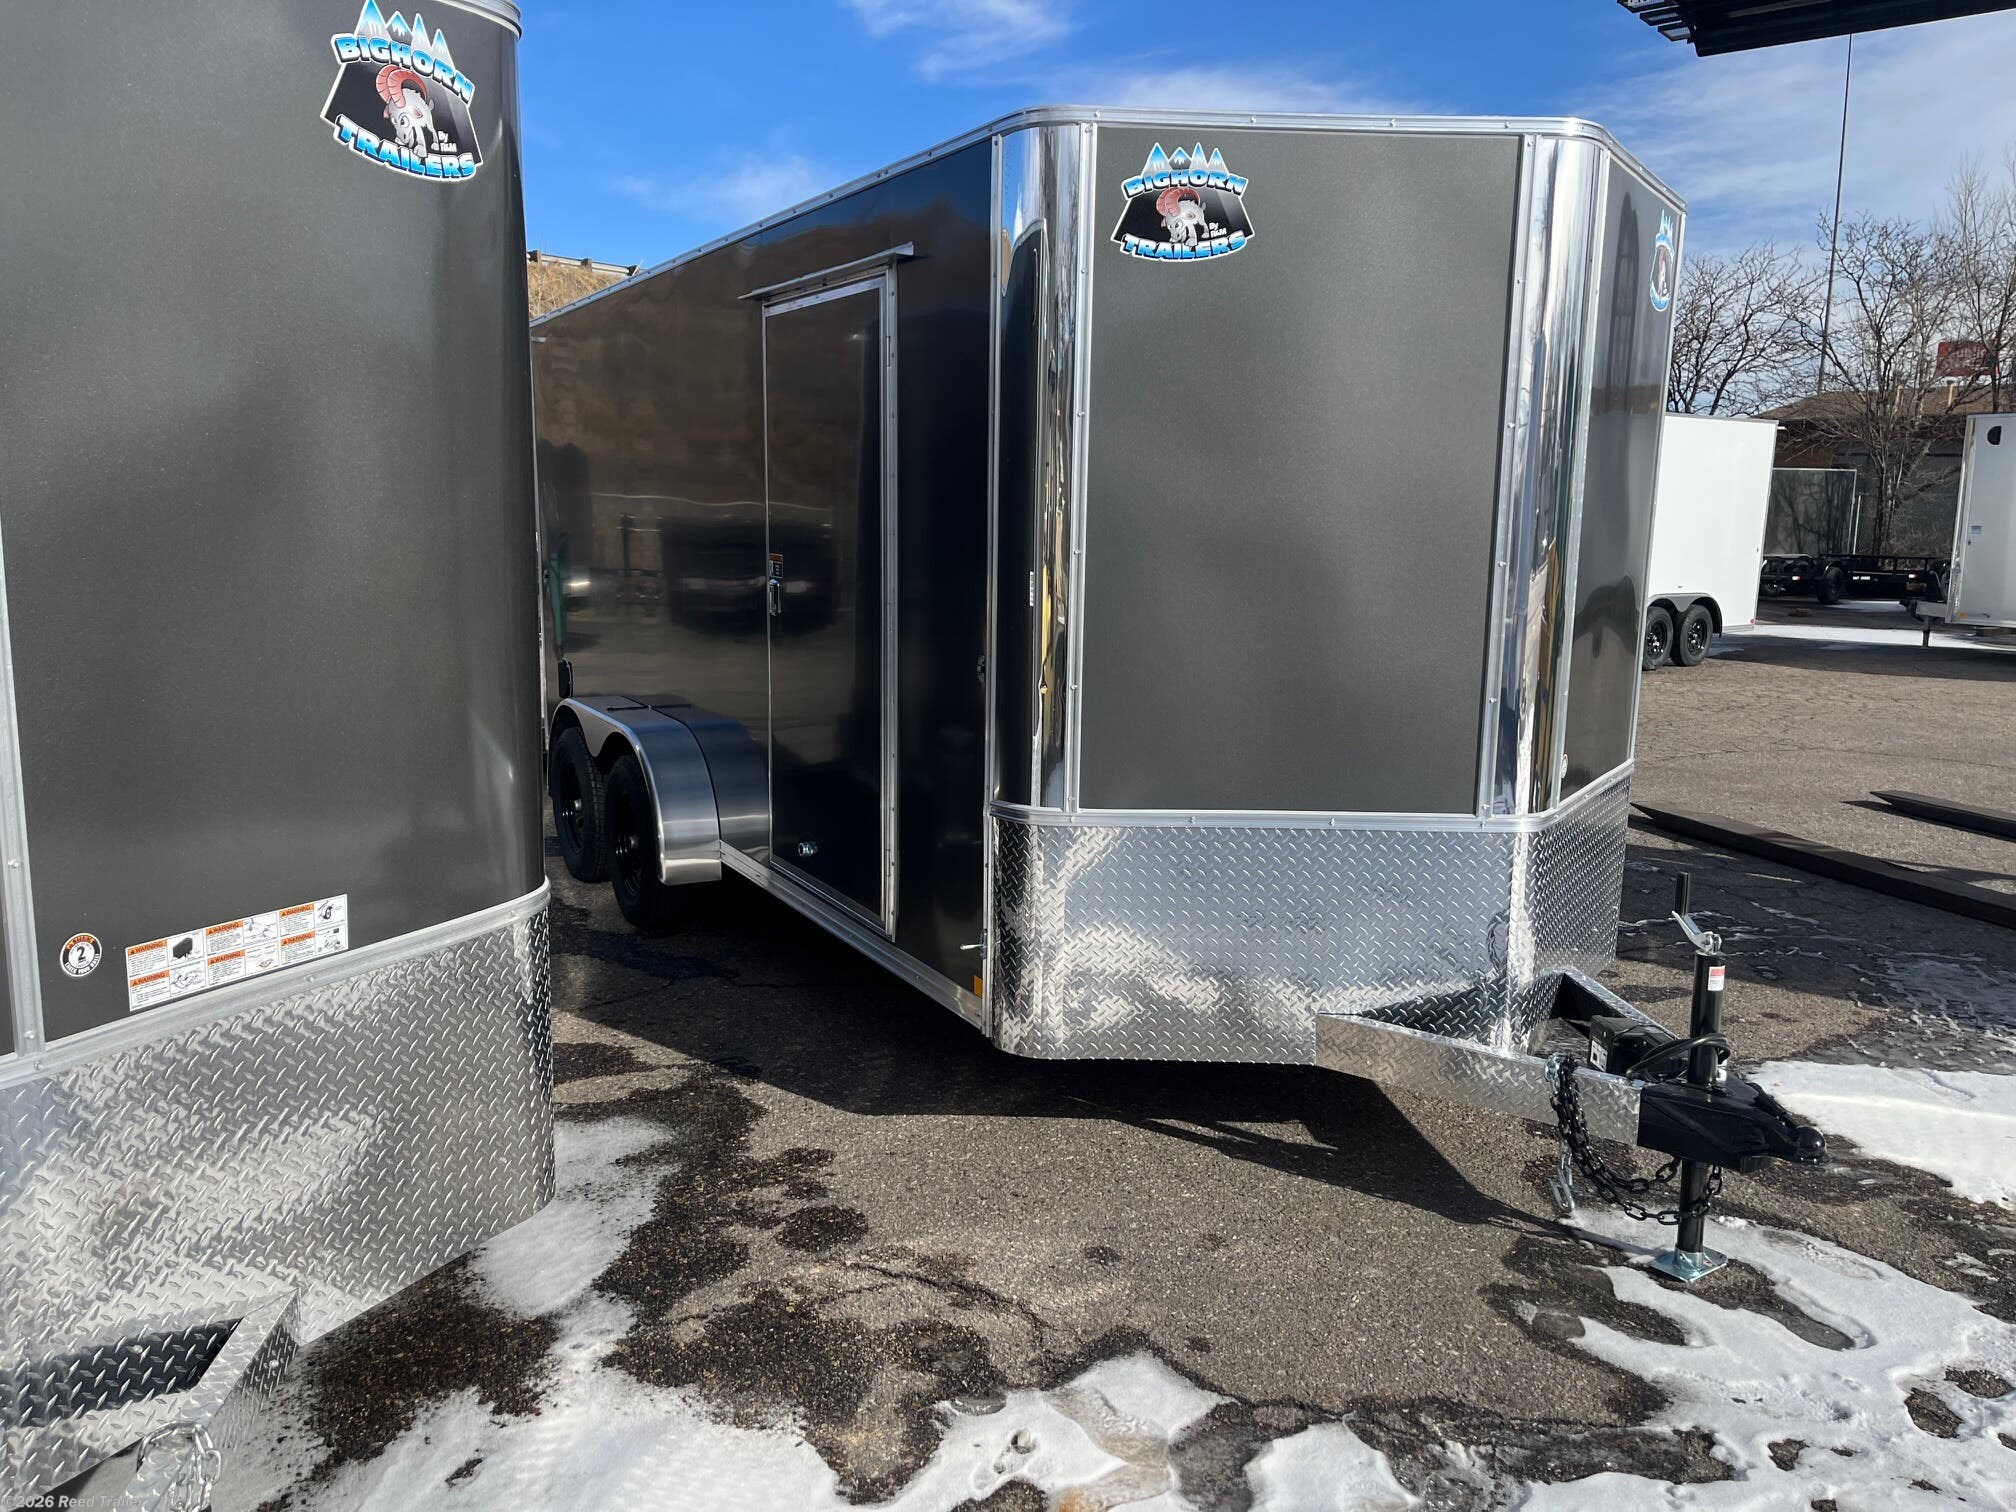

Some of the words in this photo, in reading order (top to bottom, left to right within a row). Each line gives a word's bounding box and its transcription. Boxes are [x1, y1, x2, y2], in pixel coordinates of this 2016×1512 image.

[334, 36, 475, 104] BIGHORN
[438, 131, 448, 143] By
[335, 114, 476, 179] TRAILERS
[1124, 169, 1247, 196] BIGHORN
[1209, 222, 1218, 231] By
[1122, 230, 1247, 260] TRAILERS
[213, 921, 240, 933] WARNING
[77, 946, 86, 961] 2
[135, 941, 163, 953] WARNING
[137, 972, 166, 985] WARNING
